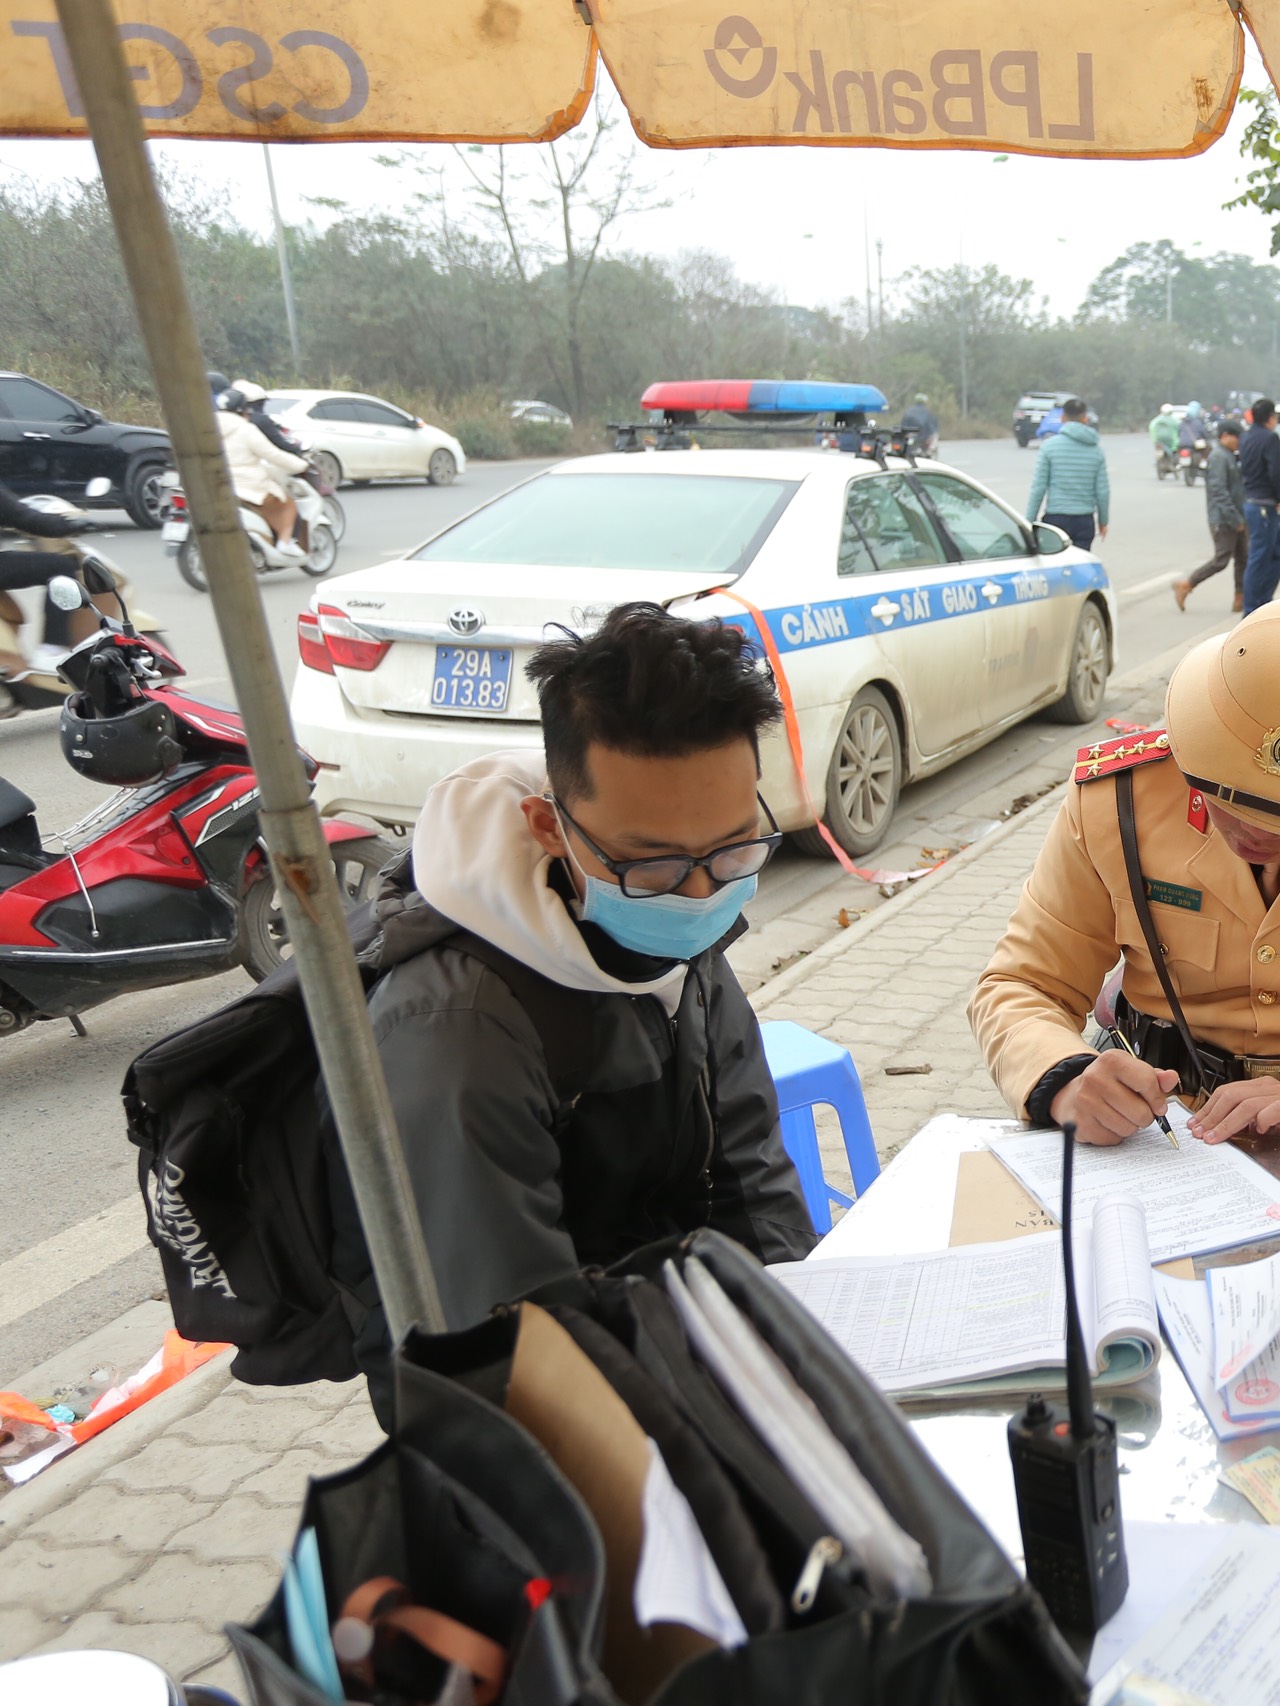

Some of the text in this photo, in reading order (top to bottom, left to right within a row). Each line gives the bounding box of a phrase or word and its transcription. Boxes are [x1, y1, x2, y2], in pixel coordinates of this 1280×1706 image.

[781, 572, 1049, 645] CẢNH SÁT GIAO THÔNG
[451, 649, 492, 678] 29A
[432, 677, 506, 708] 013.83
